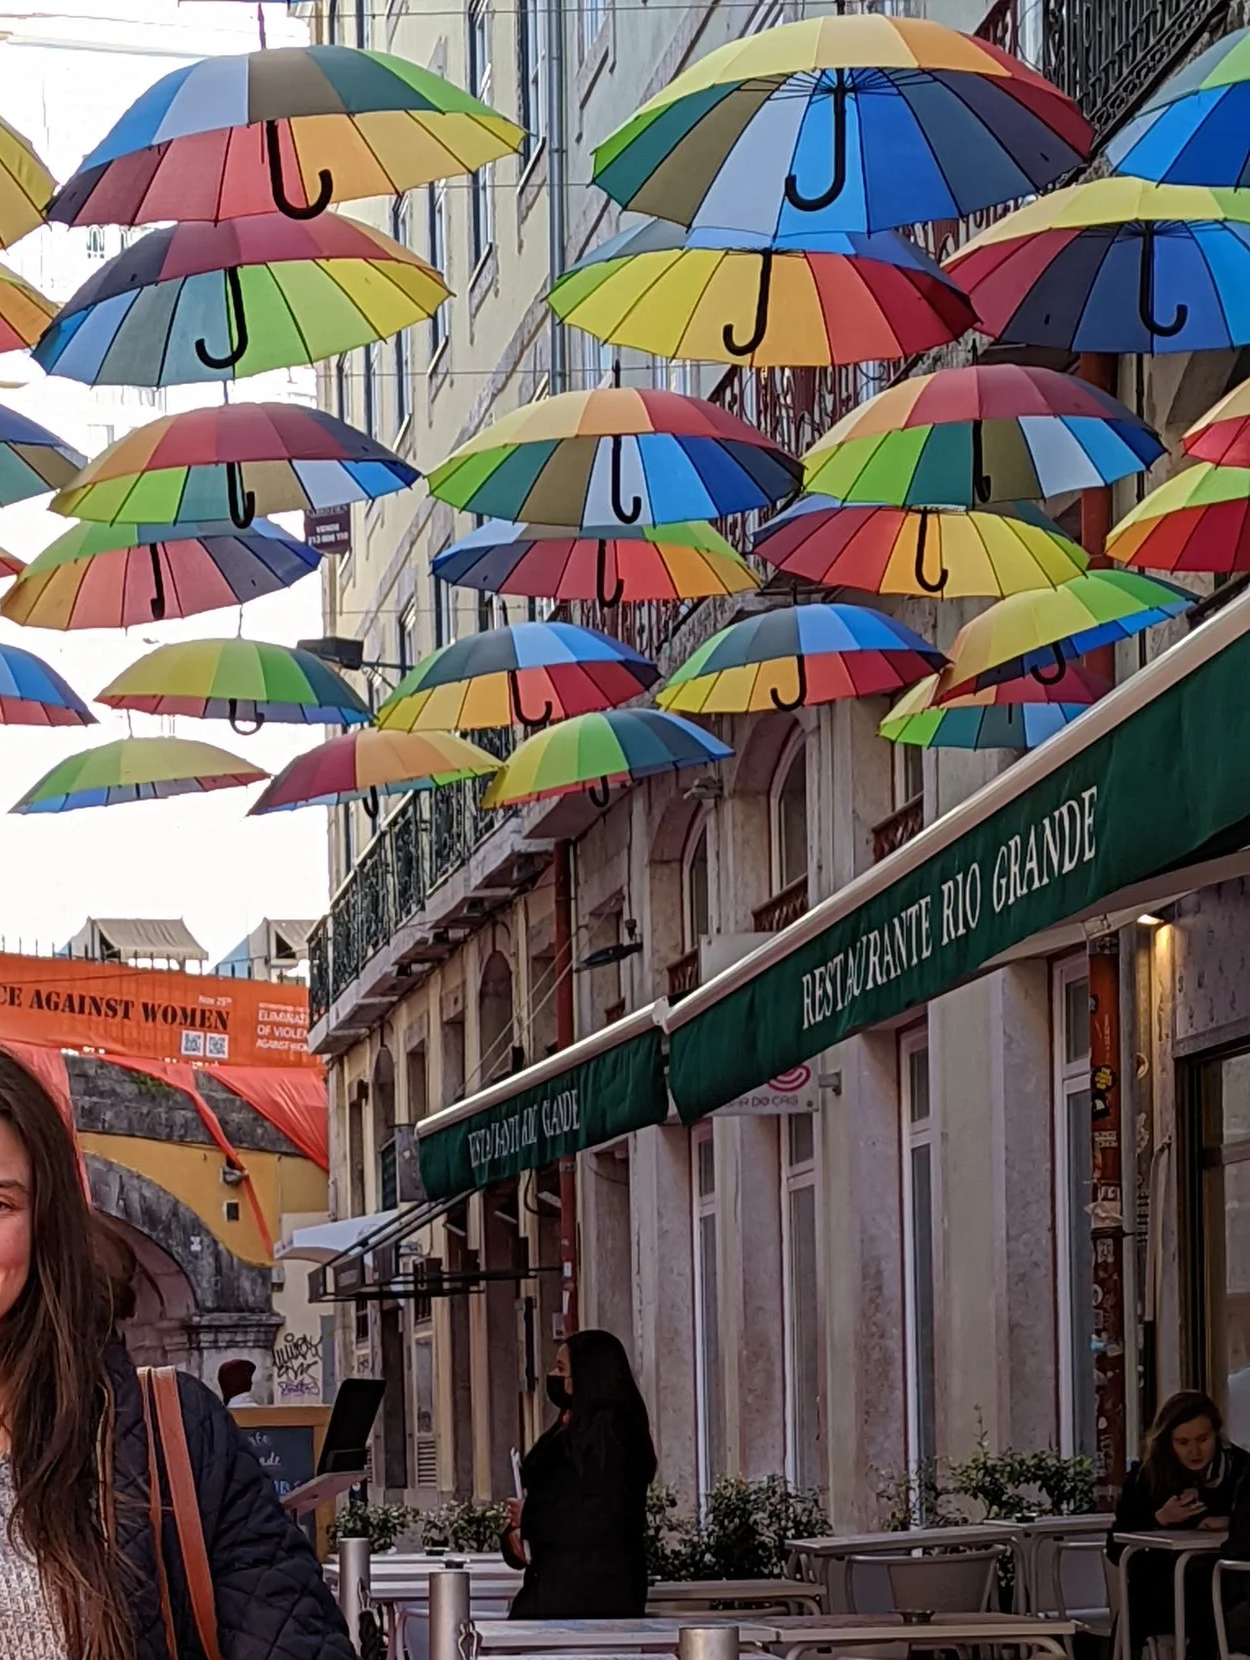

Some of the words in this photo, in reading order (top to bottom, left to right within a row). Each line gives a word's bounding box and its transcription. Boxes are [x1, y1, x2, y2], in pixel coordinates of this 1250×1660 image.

[802, 895, 933, 1030] RESTAURANTE
[941, 862, 981, 946] RIO
[992, 785, 1098, 914] GRANDE
[29, 989, 135, 1020] AGAINST
[142, 1002, 230, 1031] WOMEN
[257, 1024, 271, 1035] OF
